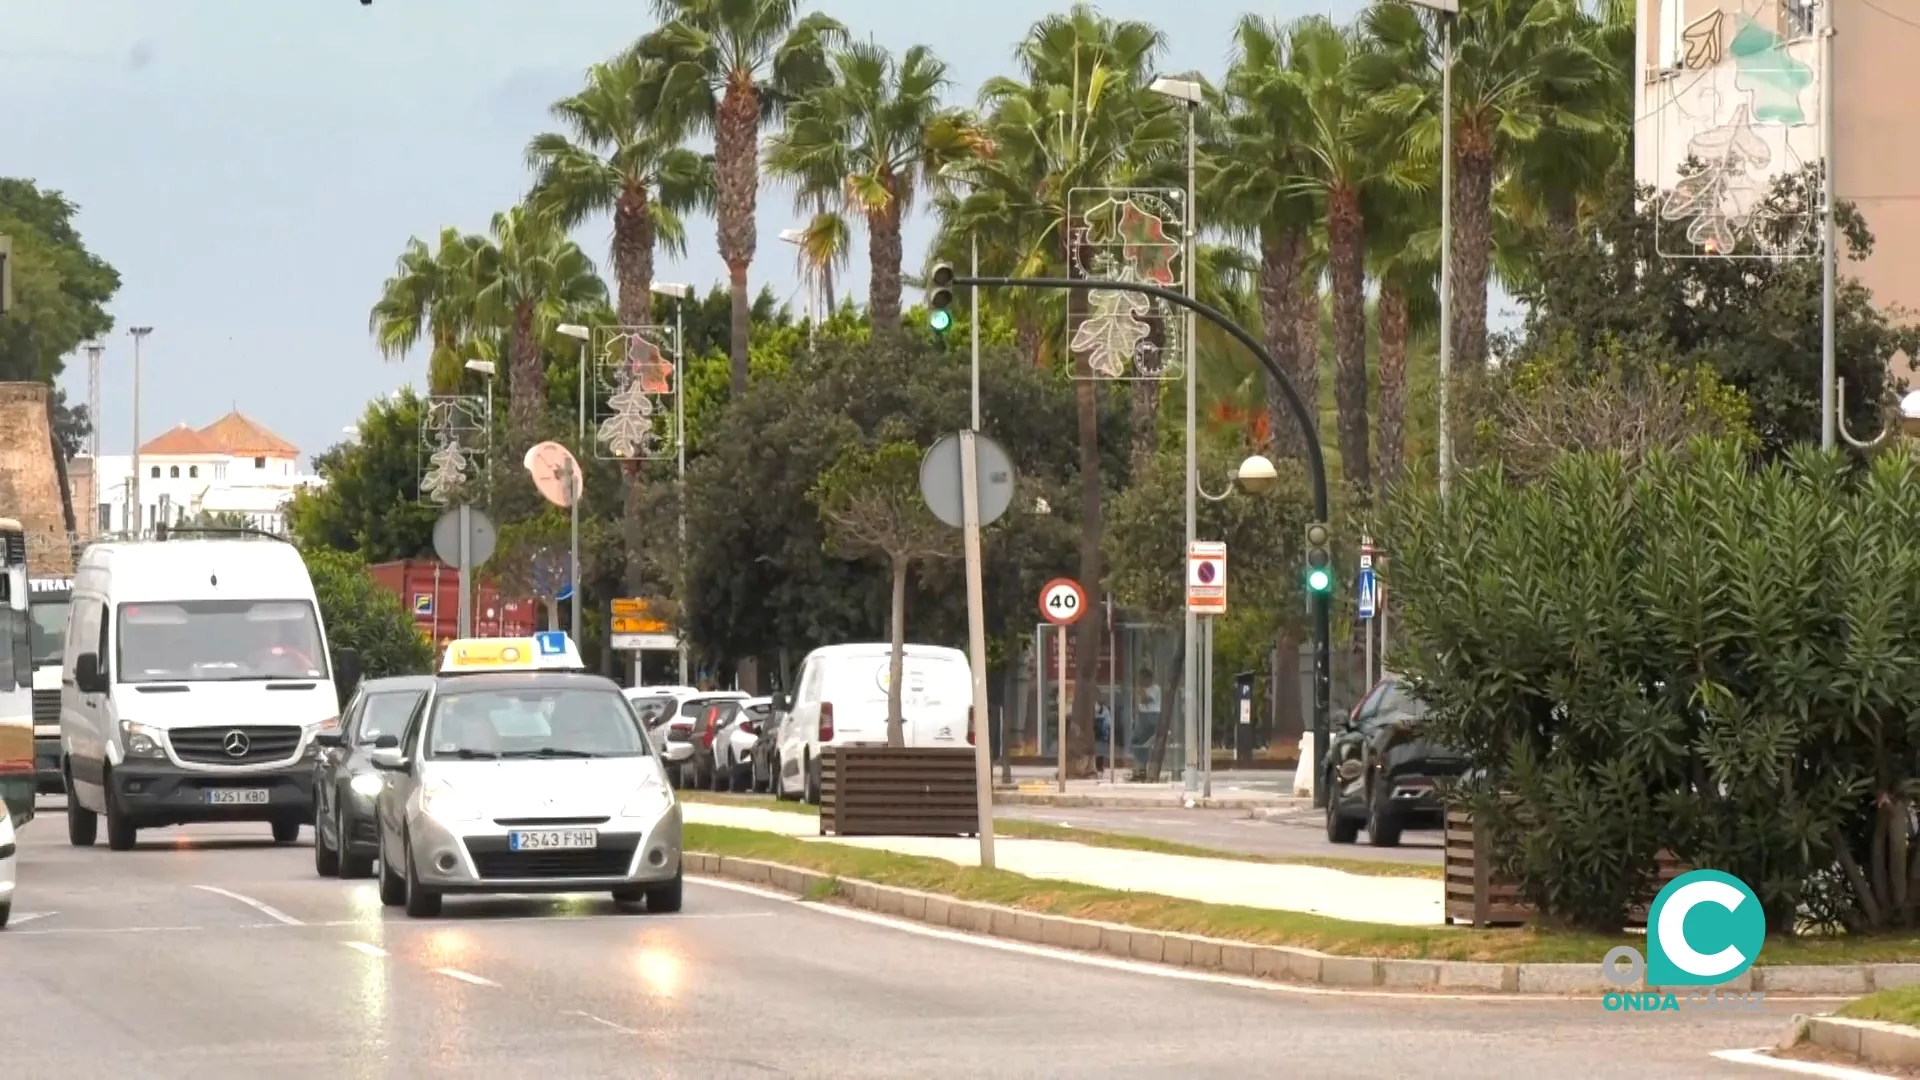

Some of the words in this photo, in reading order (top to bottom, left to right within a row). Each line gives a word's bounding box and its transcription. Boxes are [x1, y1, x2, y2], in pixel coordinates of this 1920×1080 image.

[1049, 594, 1077, 609] 40
[542, 635, 560, 652] L
[520, 832, 560, 849] 2543
